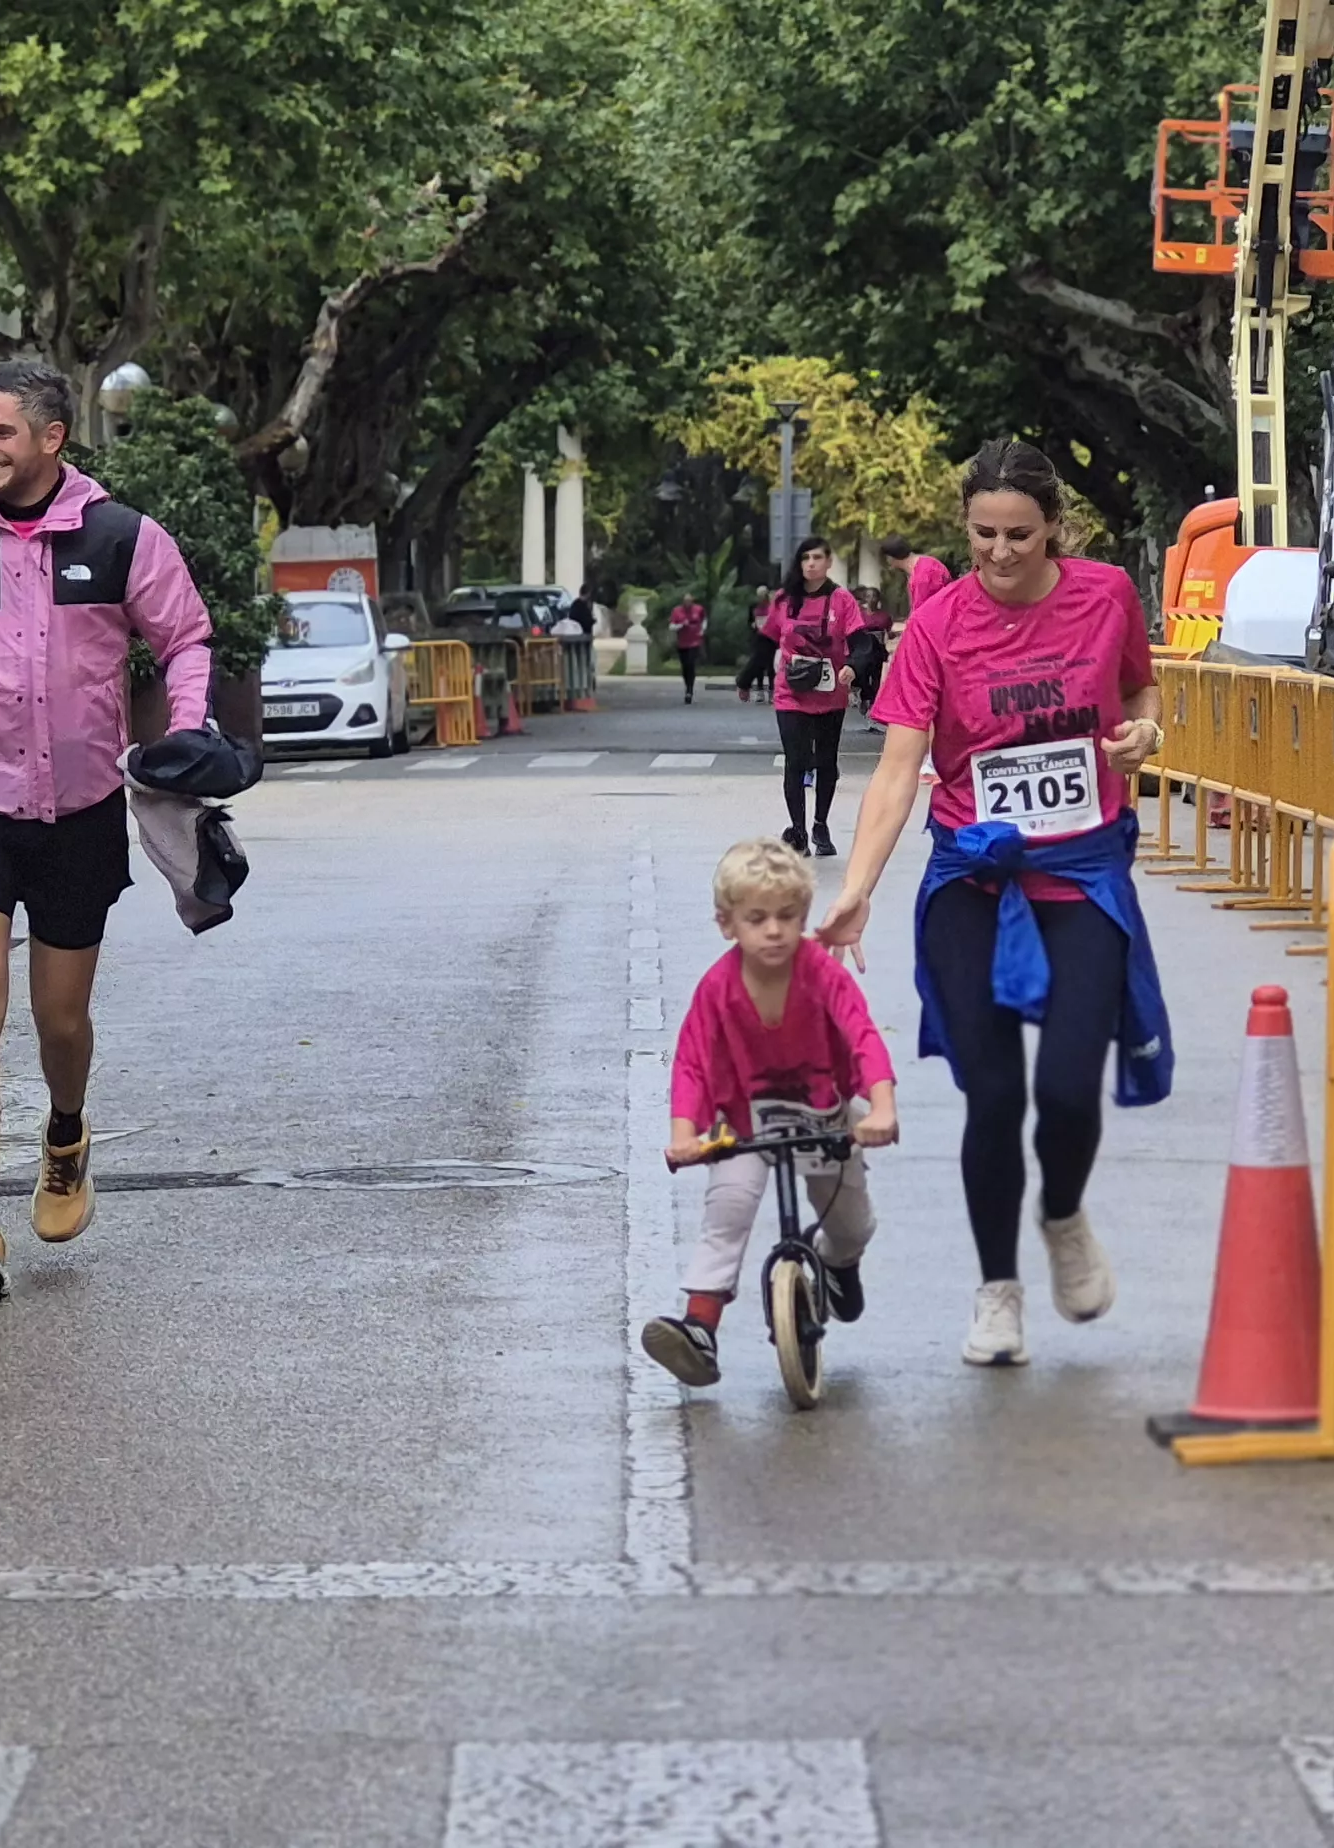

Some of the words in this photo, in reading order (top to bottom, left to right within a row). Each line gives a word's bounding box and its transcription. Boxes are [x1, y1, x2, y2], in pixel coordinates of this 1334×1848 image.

[990, 679, 1066, 717] UNIDOS
[986, 764, 1027, 778] CONTRA
[1028, 763, 1040, 773] EL
[1041, 758, 1081, 771] CÁNCER
[987, 771, 1086, 815] 2105
